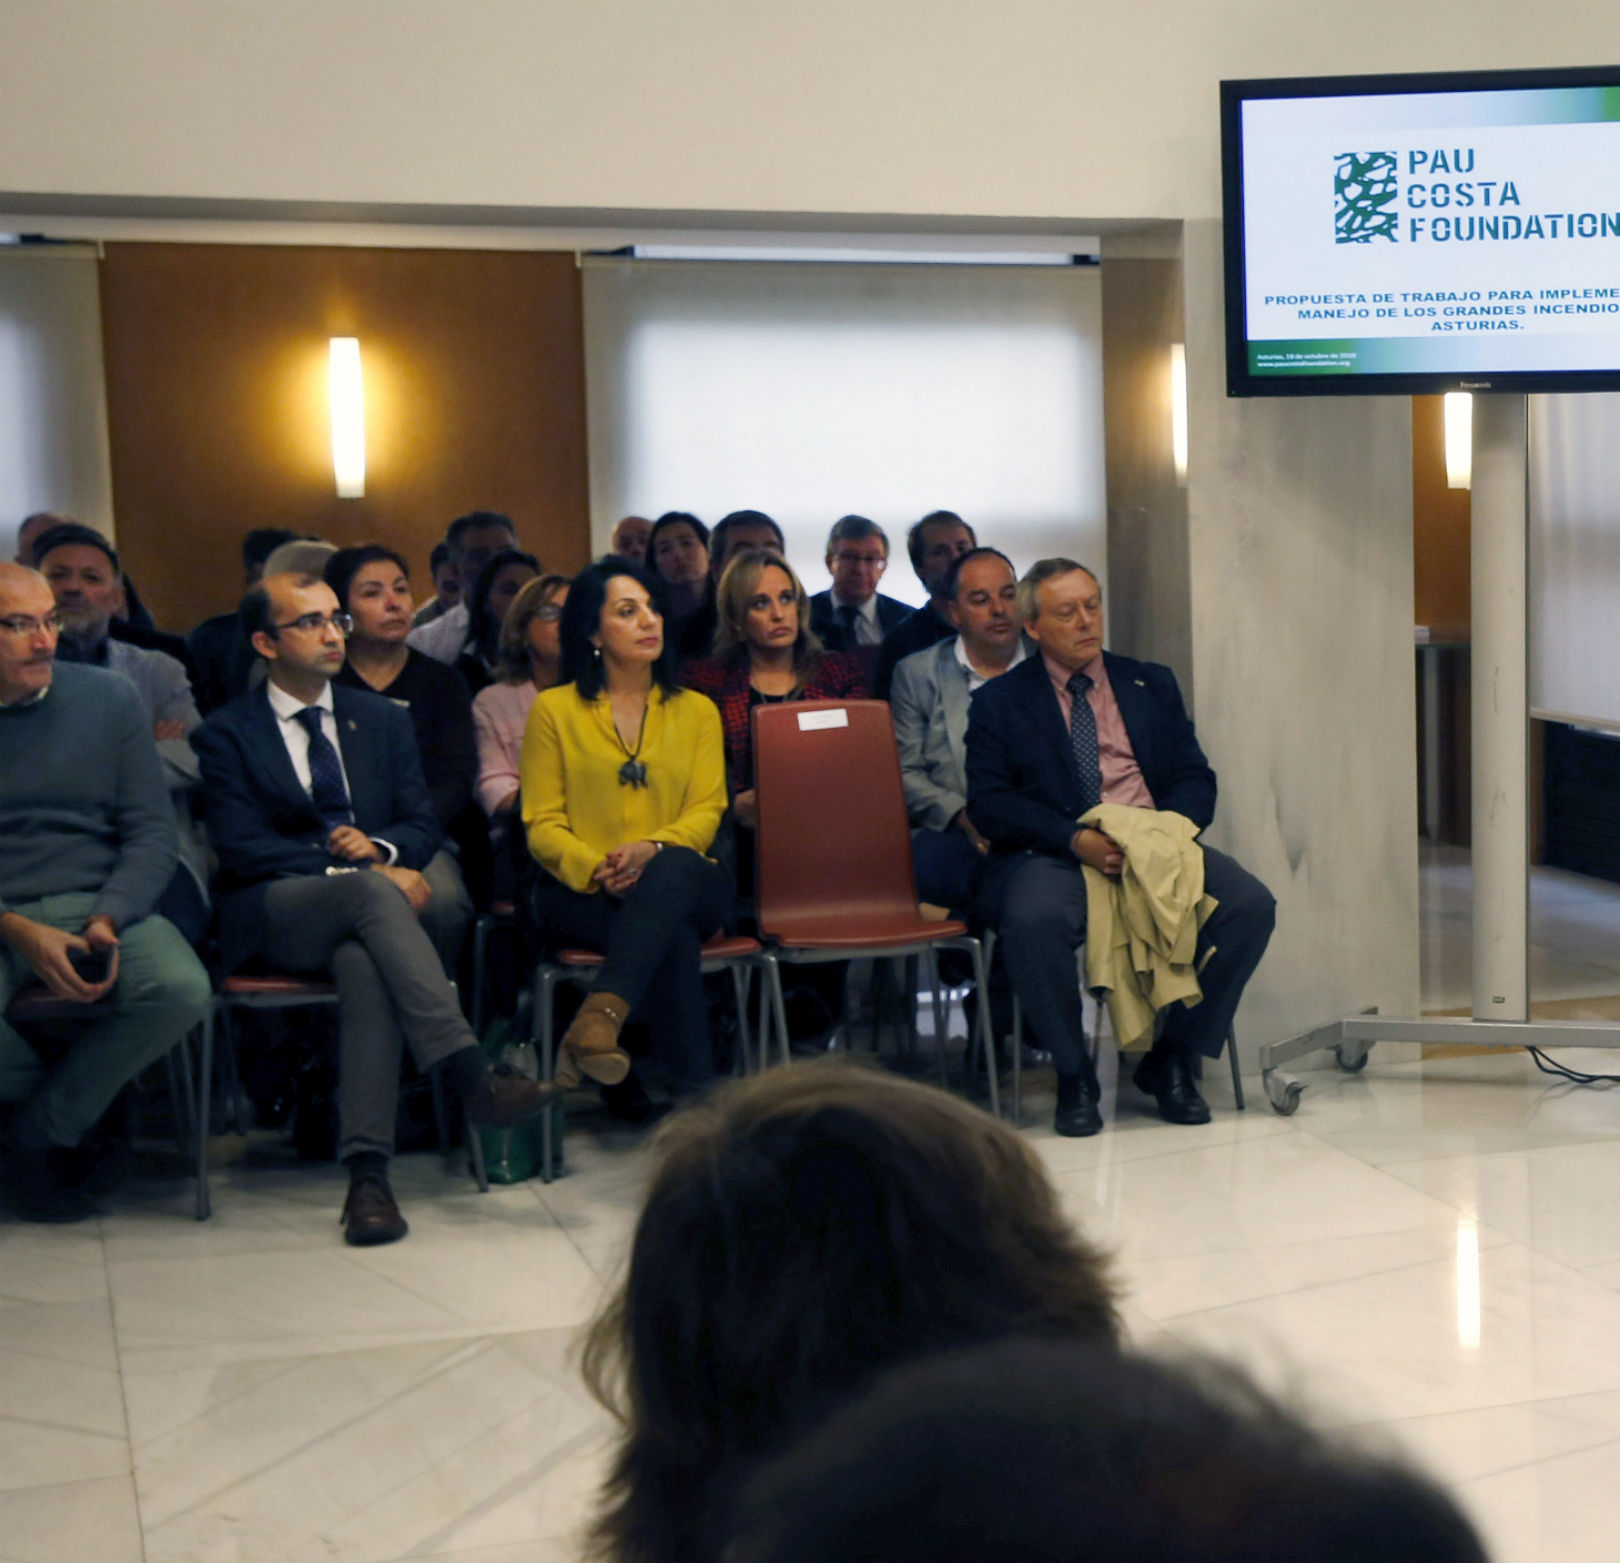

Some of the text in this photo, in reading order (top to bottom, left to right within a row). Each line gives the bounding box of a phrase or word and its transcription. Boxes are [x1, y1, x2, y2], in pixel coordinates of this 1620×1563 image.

[1408, 148, 1475, 175] PAU
[1407, 181, 1521, 209] COSTA
[1264, 293, 1367, 306] PROPUESTA
[1372, 293, 1395, 304] DE
[1400, 291, 1482, 303] TRABAJO
[1488, 290, 1533, 301] PARA
[1298, 308, 1370, 320] MANEJO
[1376, 308, 1398, 318] DE
[1403, 307, 1437, 318] LOS
[1442, 305, 1527, 317] GRANDES
[1431, 319, 1525, 332] ASTURIAS.
